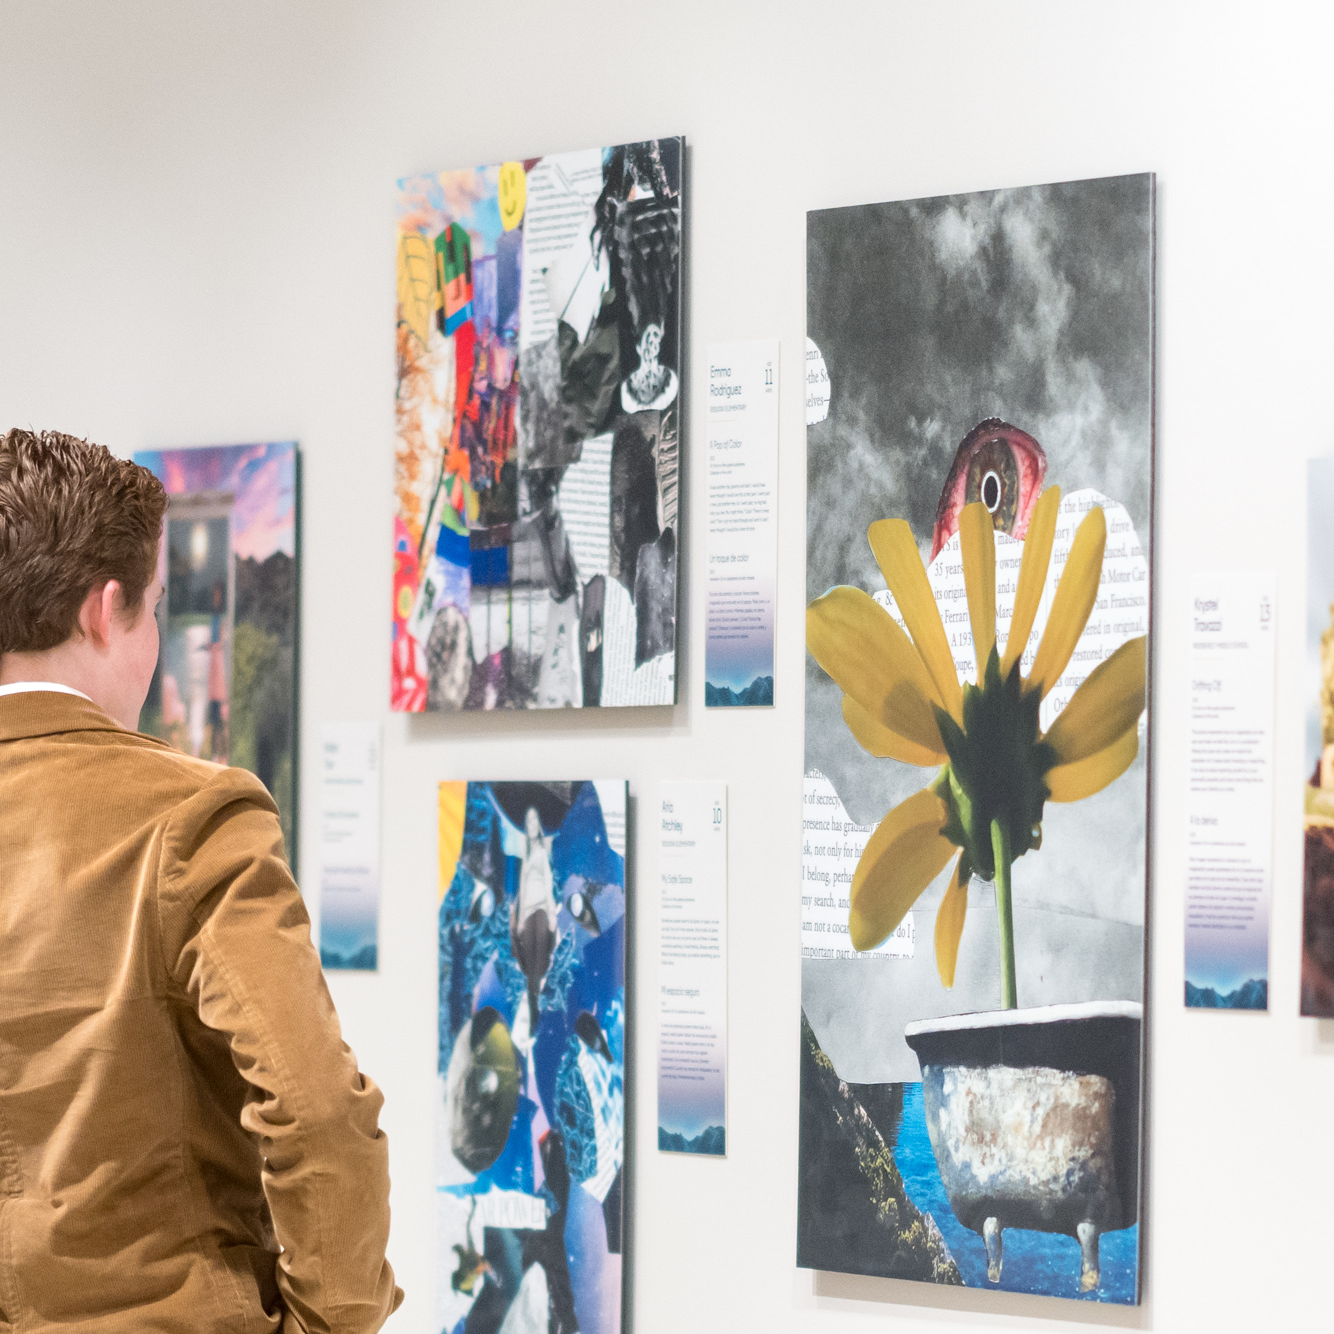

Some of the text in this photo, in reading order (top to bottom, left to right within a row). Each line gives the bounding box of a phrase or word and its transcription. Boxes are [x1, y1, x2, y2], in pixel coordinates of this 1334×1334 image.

[710, 365, 732, 379] Emma
[765, 369, 773, 385] 11
[710, 383, 742, 398] Rodriguez
[935, 563, 944, 577] 35
[713, 807, 722, 824] 10
[831, 817, 842, 832] has
[814, 844, 825, 857] not
[827, 844, 841, 861] only
[807, 865, 831, 887] belong,
[814, 893, 836, 908] search,
[814, 919, 825, 933] not
